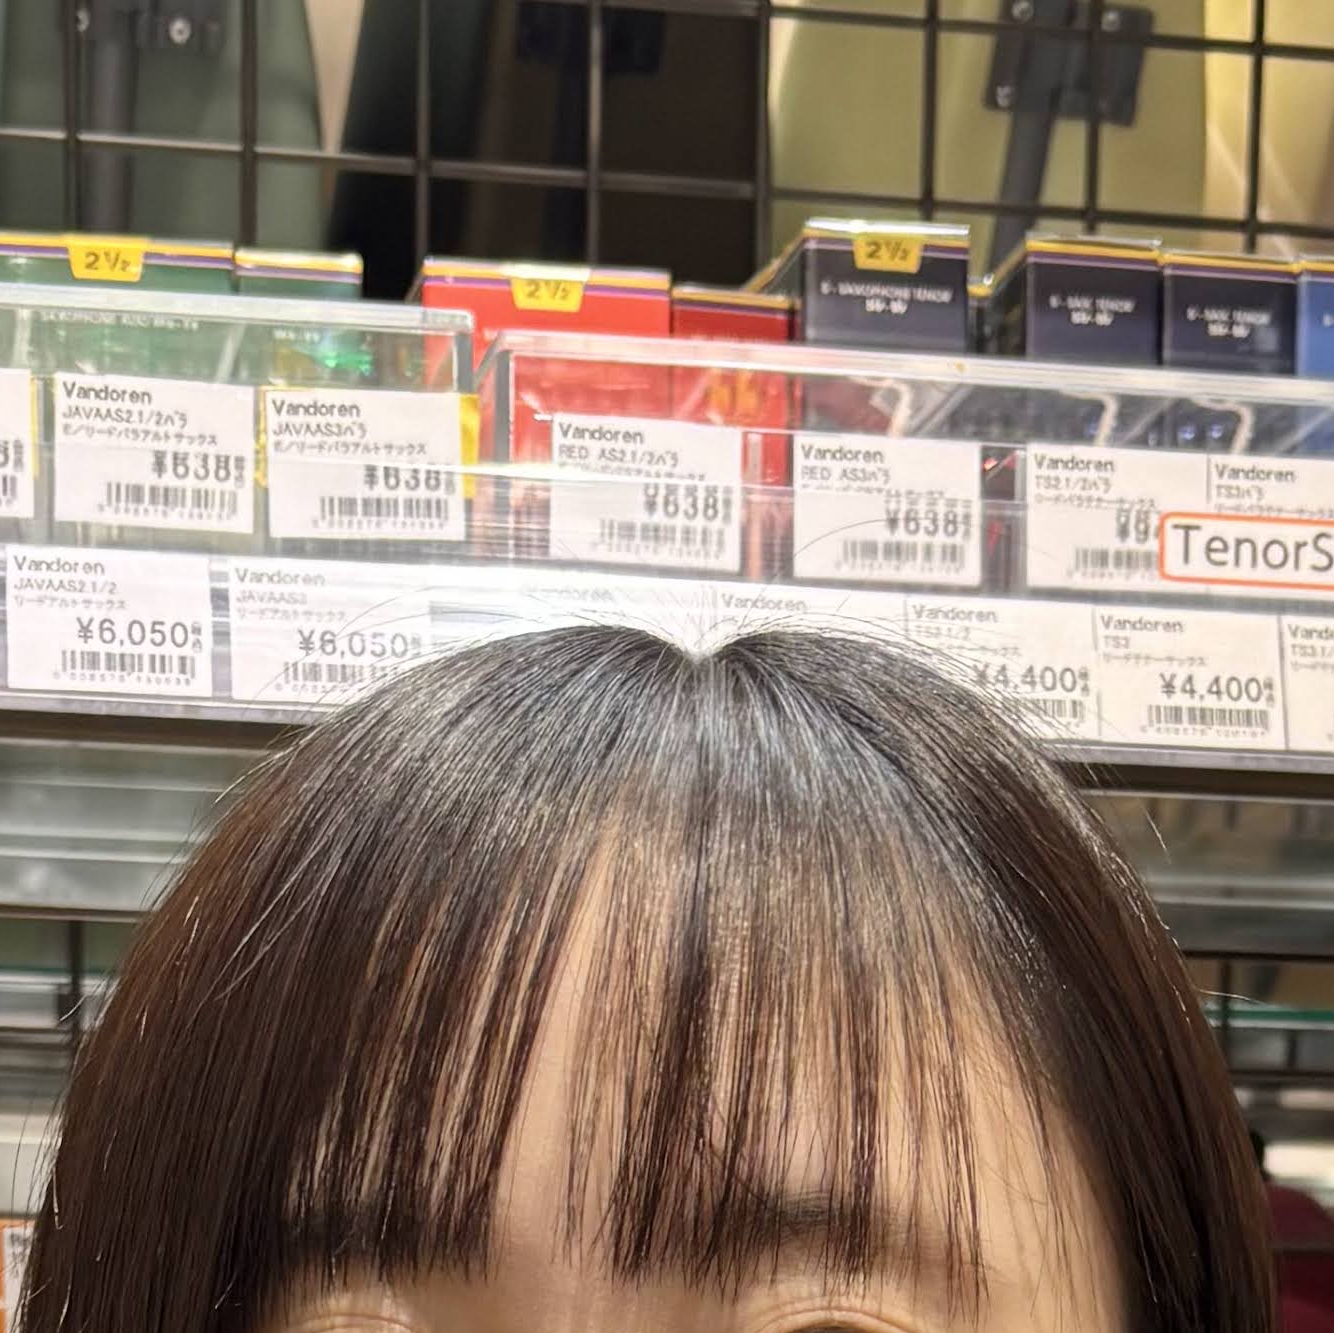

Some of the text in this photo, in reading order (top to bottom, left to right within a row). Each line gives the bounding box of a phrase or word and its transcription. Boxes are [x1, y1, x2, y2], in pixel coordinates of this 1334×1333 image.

[63, 382, 152, 404] Vandoren
[272, 399, 360, 418] Vandoren
[559, 423, 644, 444] Vandoren
[801, 444, 884, 464] Vandoren
[1035, 454, 1114, 473] Vandoren
[1215, 464, 1295, 482] Vandoren
[885, 506, 958, 536] ¥638
[13, 556, 105, 575] Vandoren
[235, 568, 326, 587] Vandoren
[76, 616, 189, 648] ¥6,050
[1101, 614, 1184, 633] Vandoren
[298, 627, 409, 659] ¥6,050
[1159, 672, 1264, 702] ¥4,400
